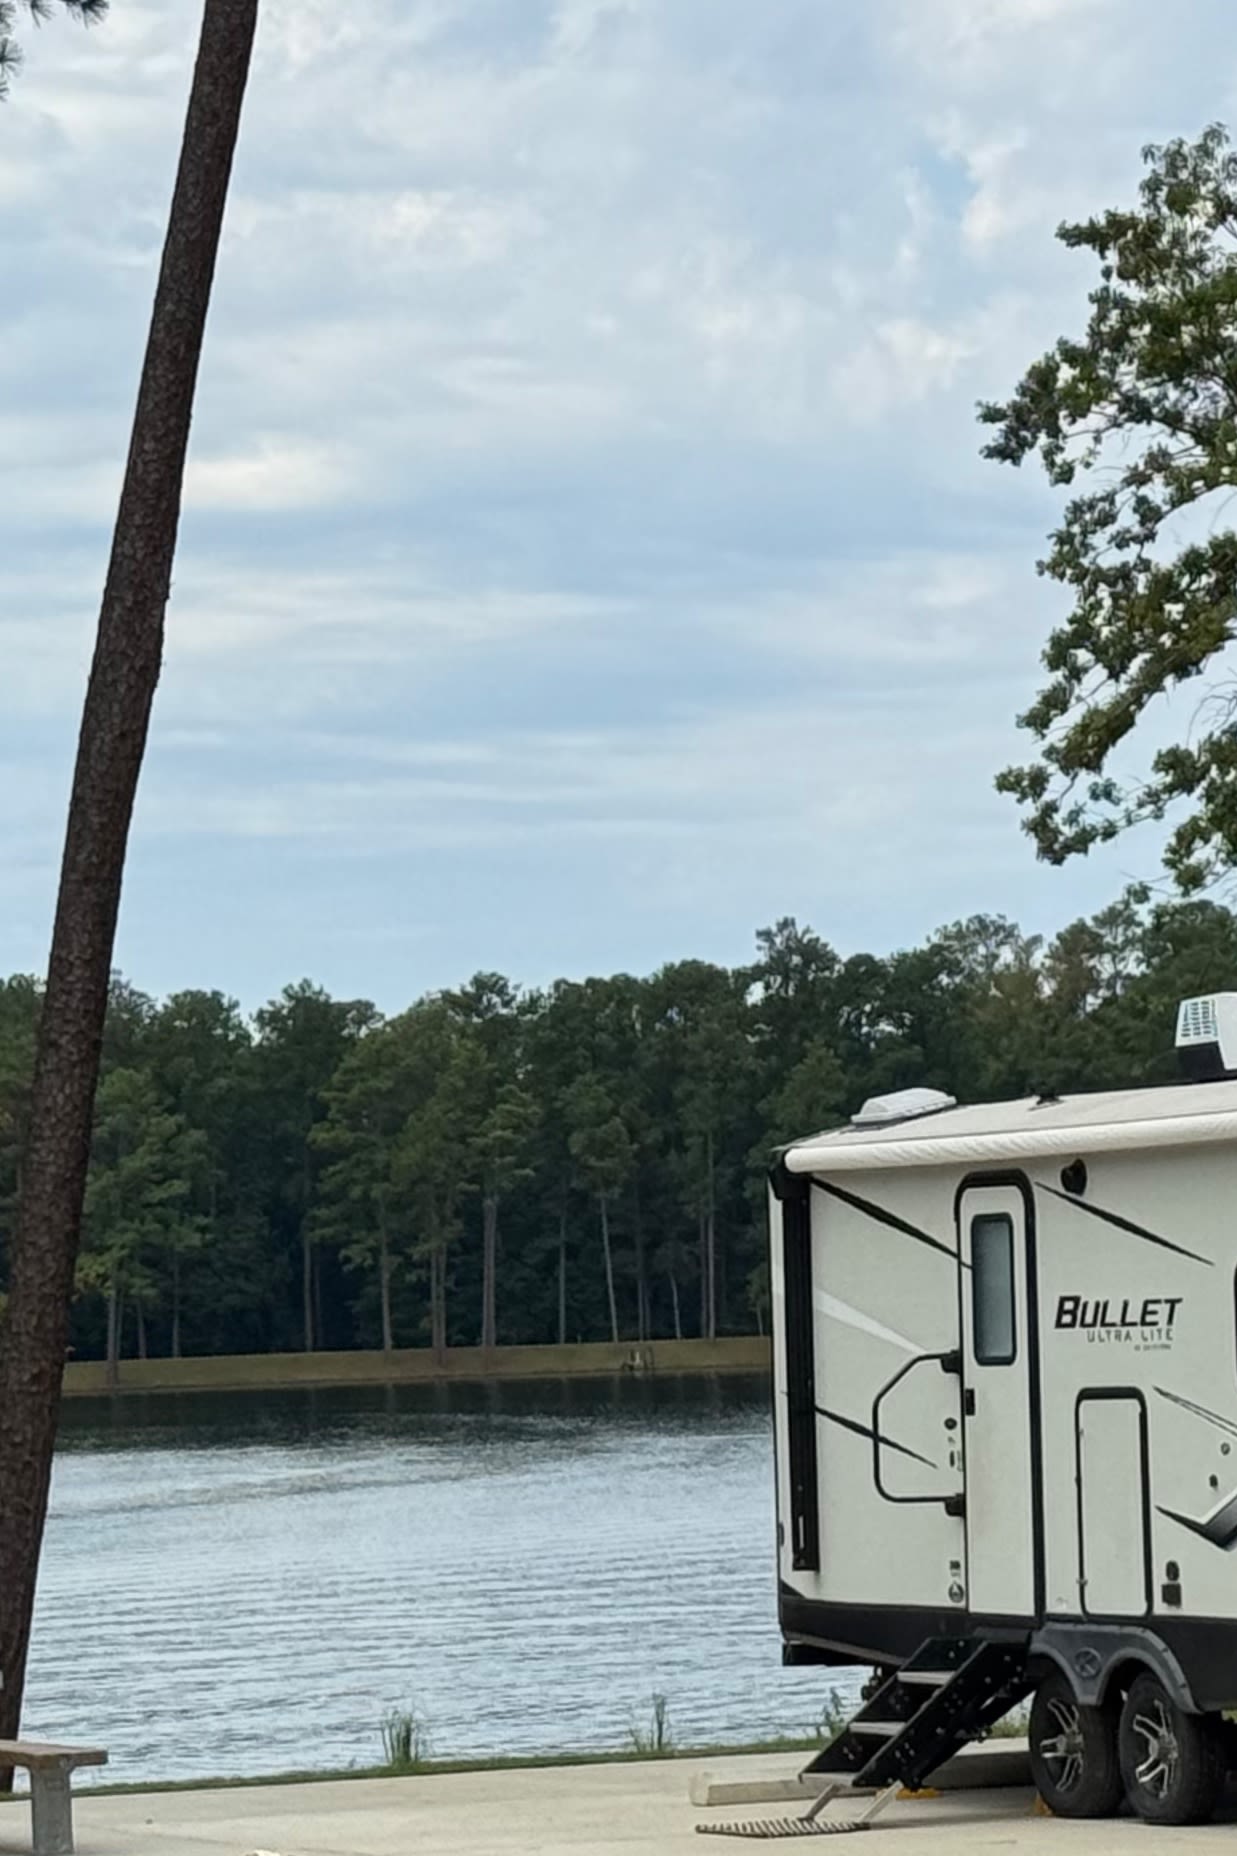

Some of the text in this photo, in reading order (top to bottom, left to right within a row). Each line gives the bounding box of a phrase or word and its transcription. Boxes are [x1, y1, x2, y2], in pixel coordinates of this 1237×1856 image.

[1054, 1295, 1183, 1329] BULLET
[1087, 1328, 1173, 1343] ULTRA LITE
